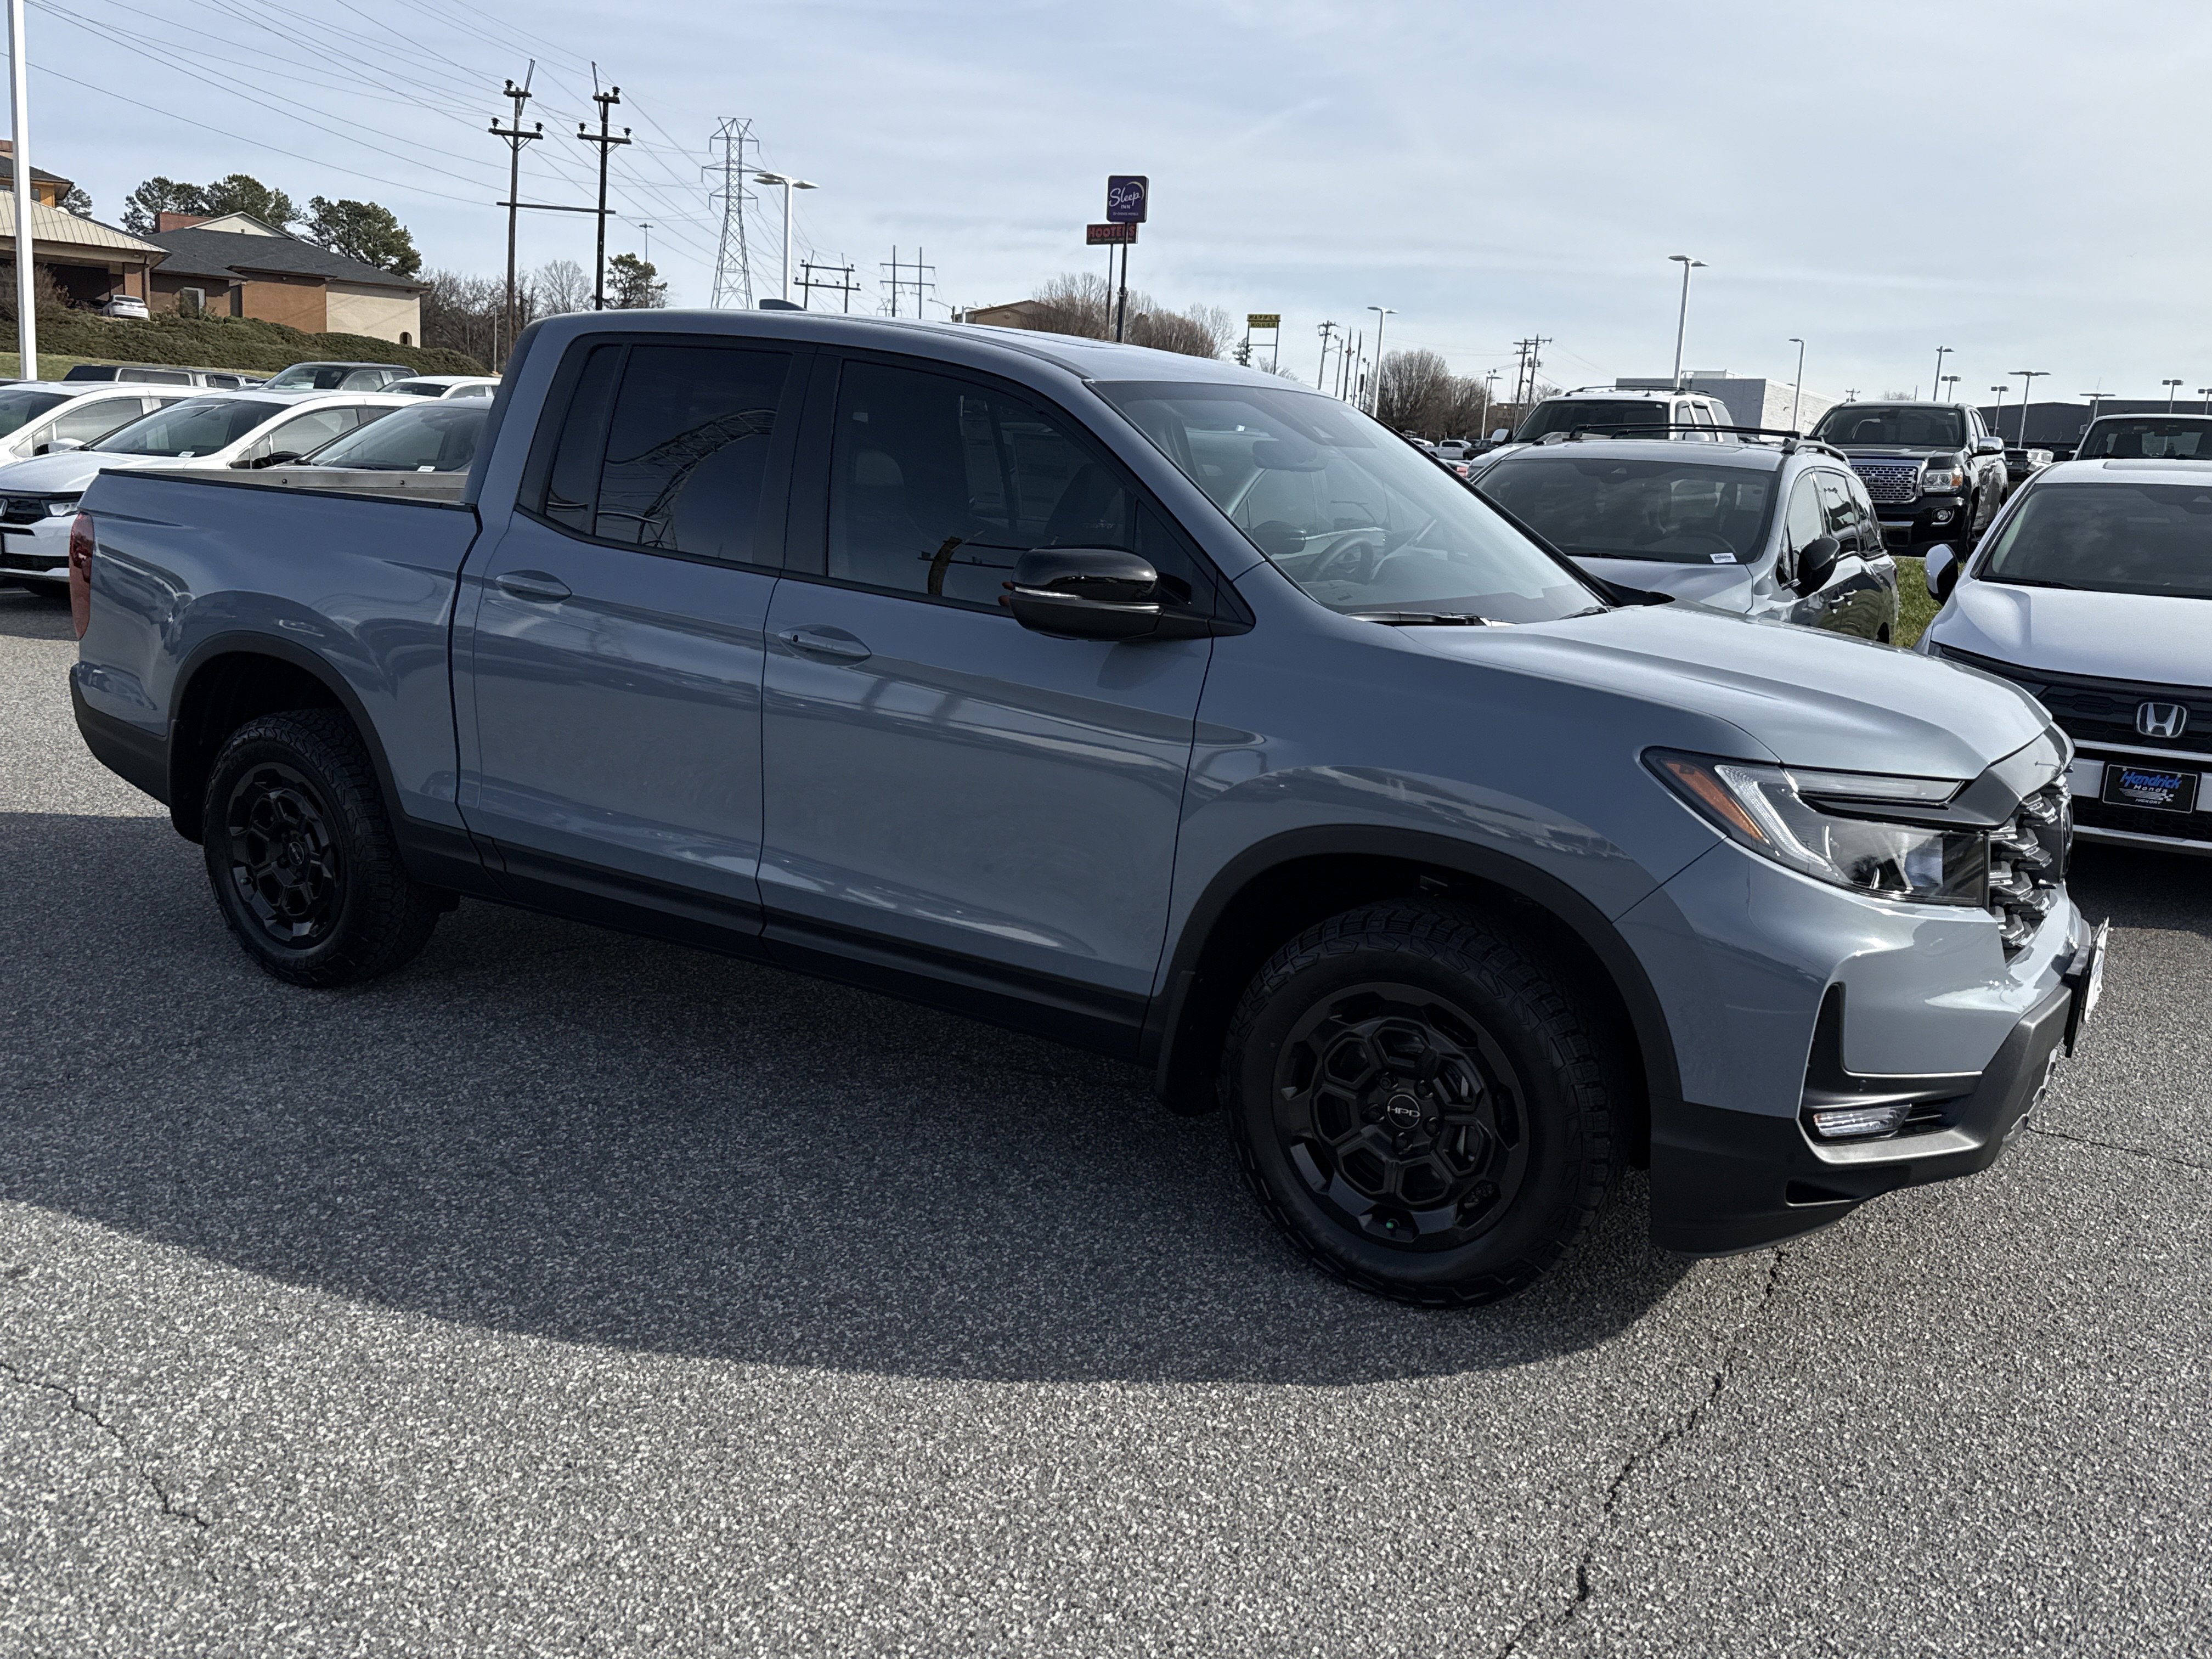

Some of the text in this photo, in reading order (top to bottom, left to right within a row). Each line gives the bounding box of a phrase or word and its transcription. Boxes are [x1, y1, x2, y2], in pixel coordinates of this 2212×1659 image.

[1109, 187, 1141, 207] Sleep
[2119, 771, 2182, 789] Hendrick
[2133, 785, 2168, 793] Honda
[1387, 1105, 1420, 1118] HPD
